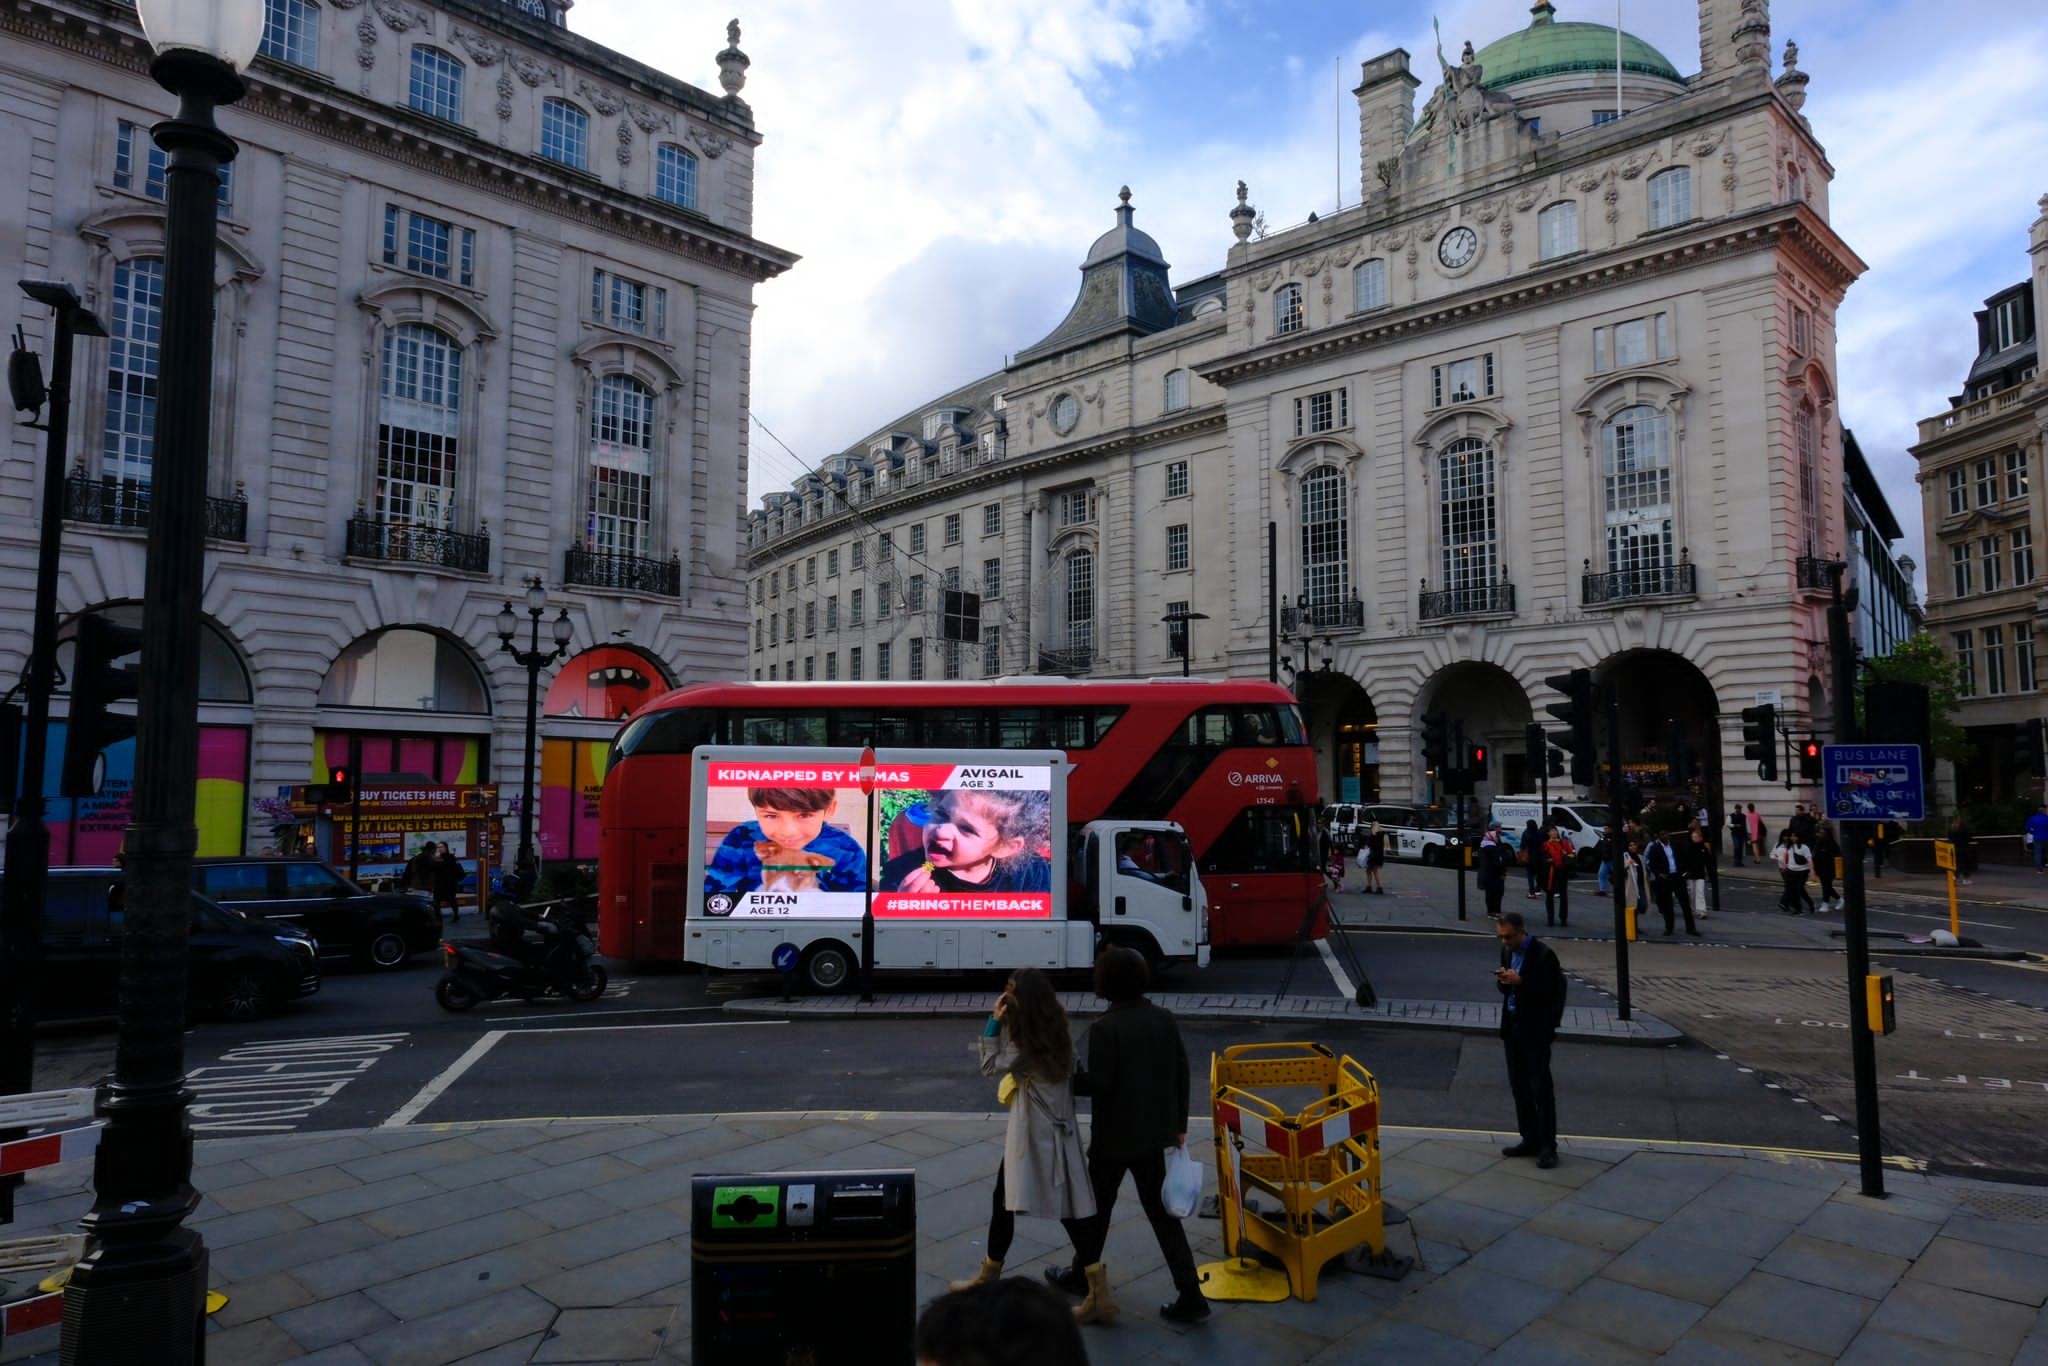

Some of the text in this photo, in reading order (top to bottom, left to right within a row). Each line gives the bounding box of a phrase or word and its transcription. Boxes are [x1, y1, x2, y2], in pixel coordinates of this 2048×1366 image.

[1834, 750, 1909, 761] BUS LANE
[717, 769, 910, 783] KIDNAPPED BY HMAS
[960, 768, 1024, 779] AVIGAIL
[1244, 773, 1284, 784] ARRIVA
[960, 780, 994, 788] AGE 3
[359, 790, 456, 800] BUY TICKETS HERE
[1498, 806, 1539, 818] openreach
[376, 820, 430, 831] TICKETS
[432, 819, 467, 830] HERE
[750, 895, 798, 905] EITAN
[887, 899, 1043, 911] #BRINGTHEMBACK
[750, 907, 789, 915] AGE 12
